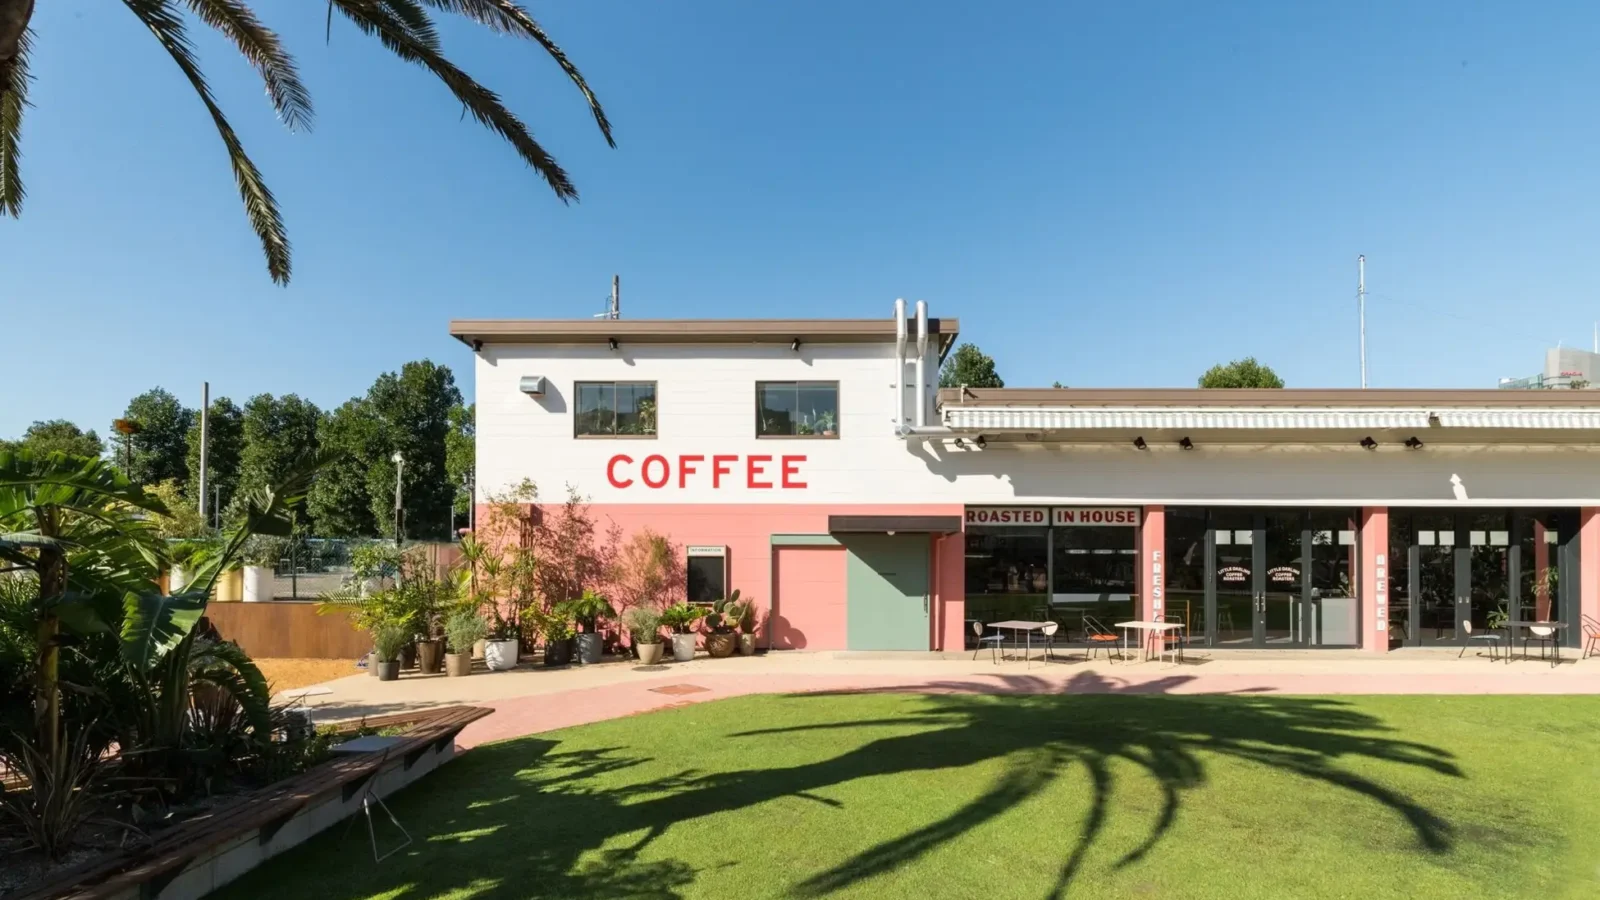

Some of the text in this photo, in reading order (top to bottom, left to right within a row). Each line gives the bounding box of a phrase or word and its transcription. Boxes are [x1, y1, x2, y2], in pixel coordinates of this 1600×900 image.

[607, 454, 807, 489] COFFEE
[966, 510, 1136, 523] ROASTED IN HOUSE
[1217, 566, 1251, 575] LITTLE DARLING
[1266, 566, 1300, 575] LITTLE DARLING
[1375, 554, 1386, 631] BREWED
